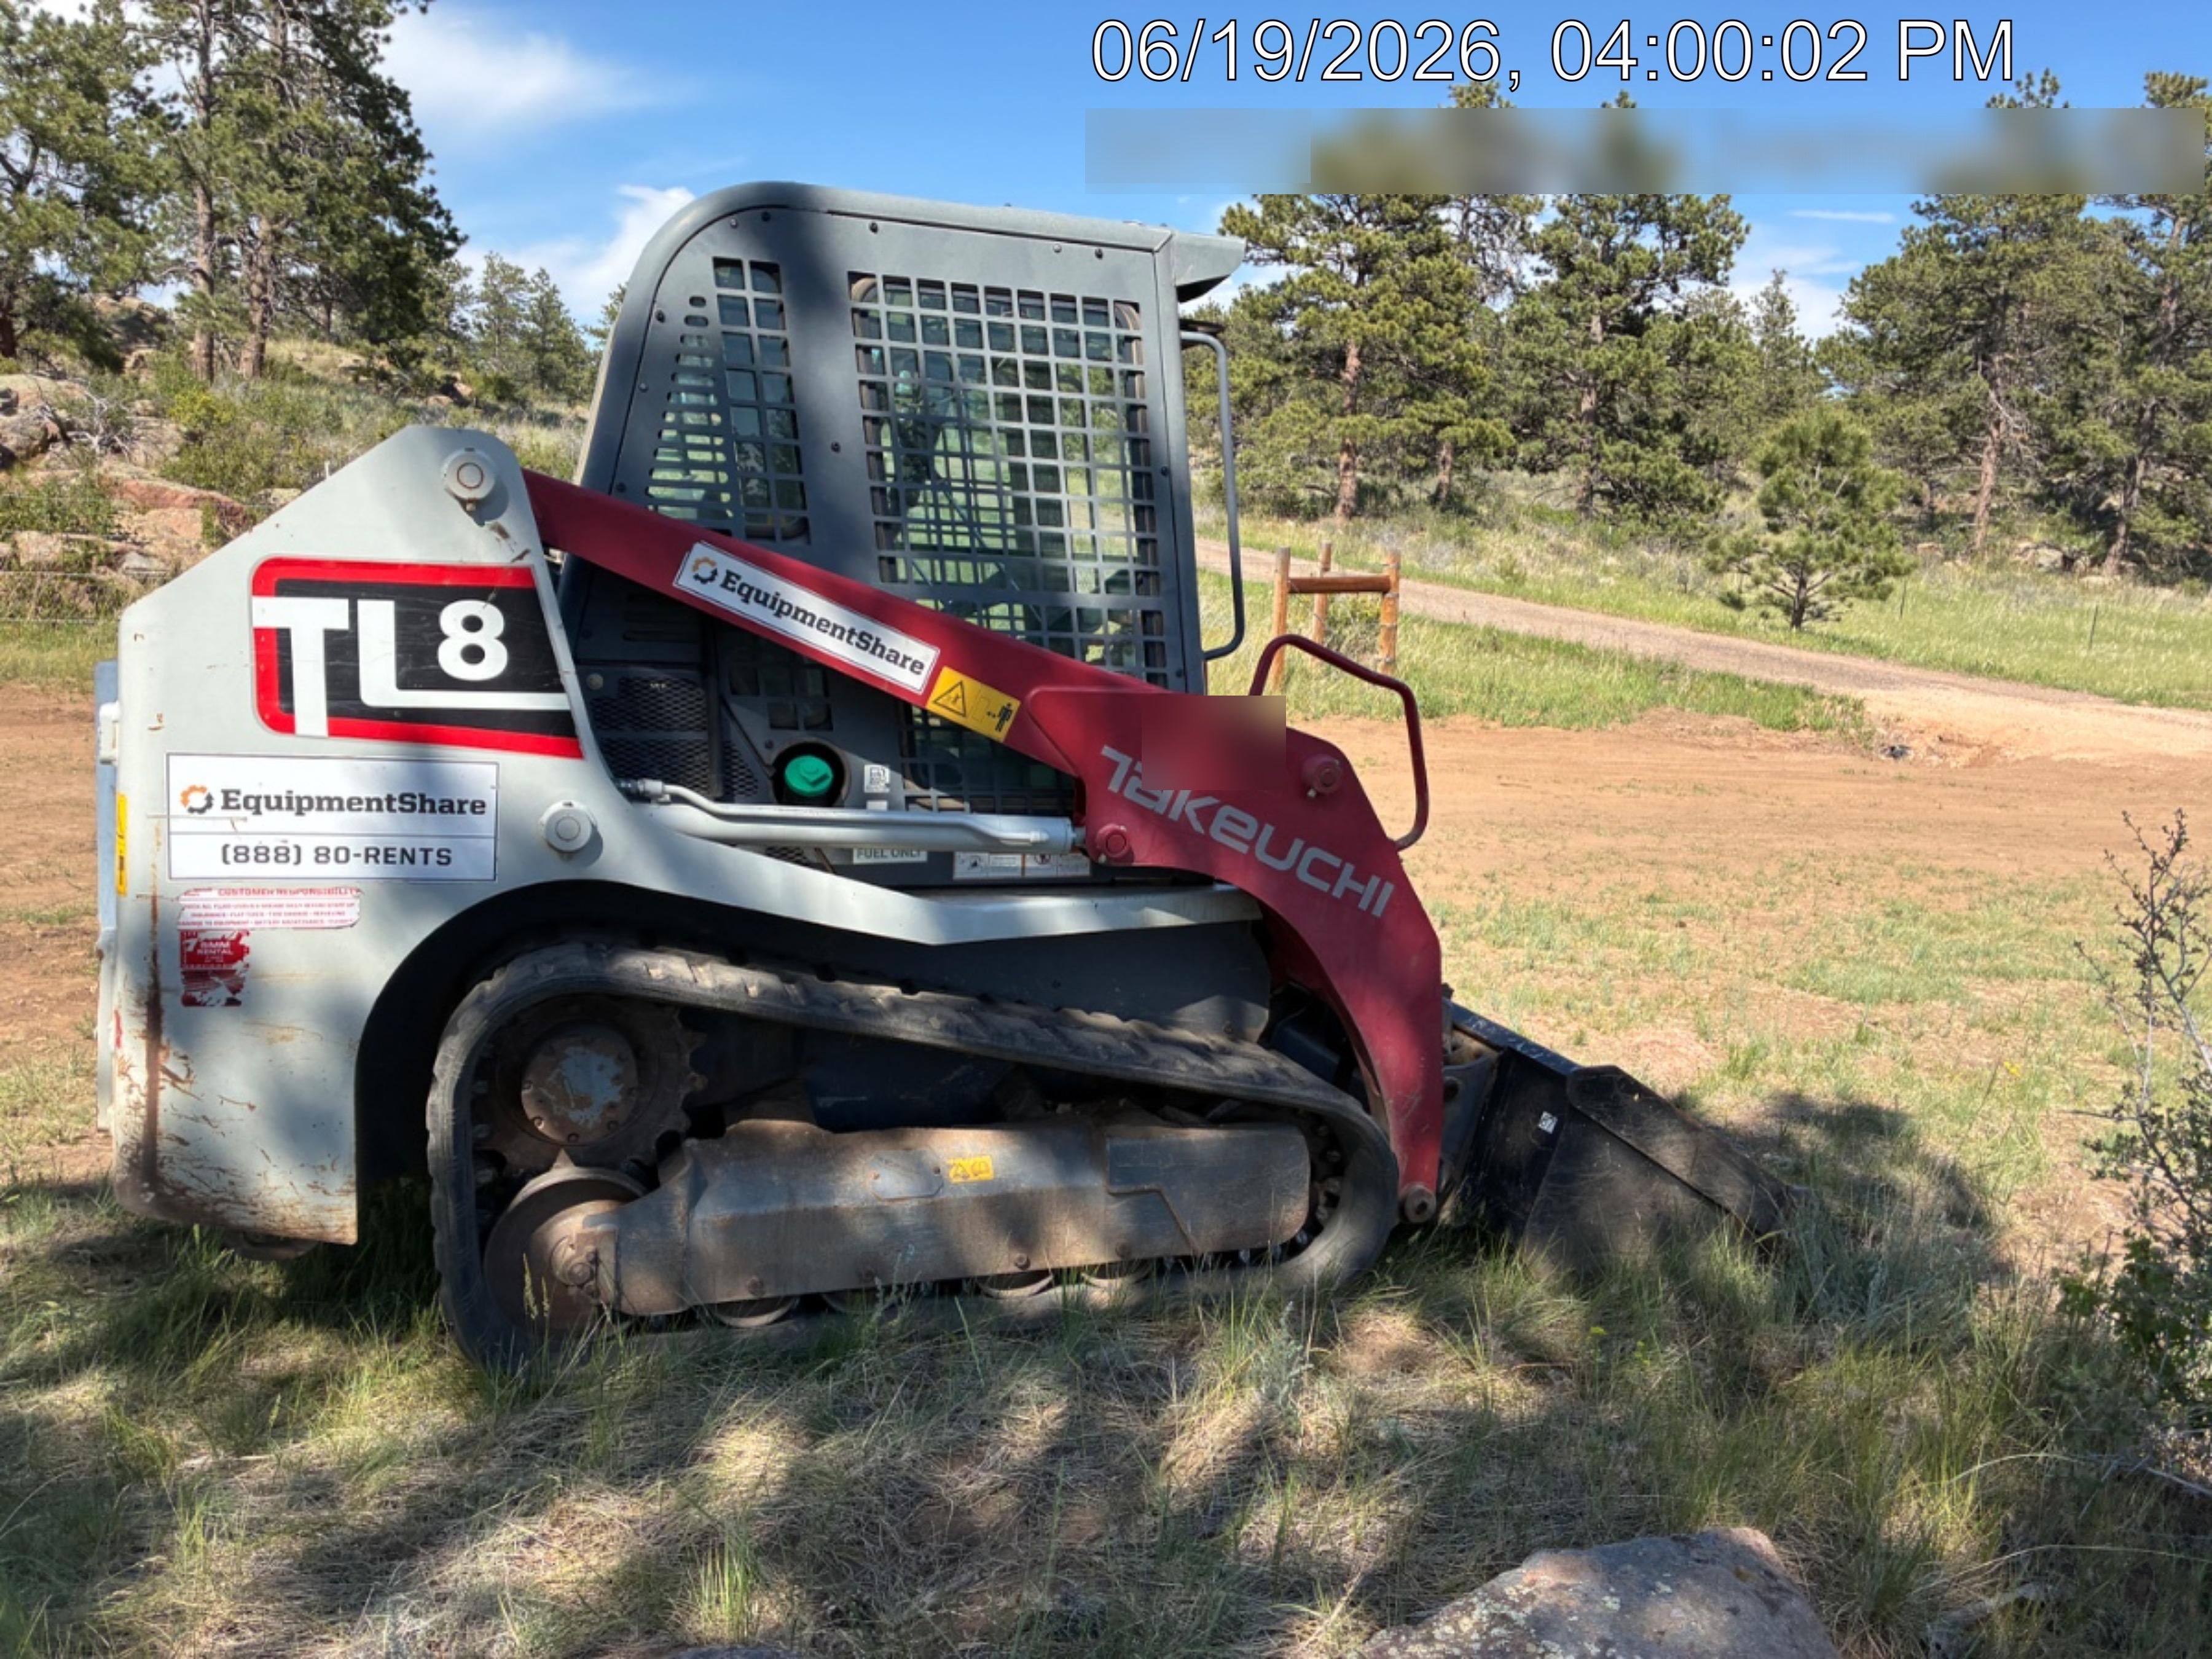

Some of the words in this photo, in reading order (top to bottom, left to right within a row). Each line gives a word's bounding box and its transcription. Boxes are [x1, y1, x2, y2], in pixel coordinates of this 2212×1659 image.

[719, 569, 925, 675] EquipmentShare
[252, 596, 571, 737] TL8
[221, 788, 487, 816] EquipmentShare
[221, 844, 302, 865] (888)
[314, 846, 452, 866] 80-RENTS
[857, 848, 888, 859] FUEL
